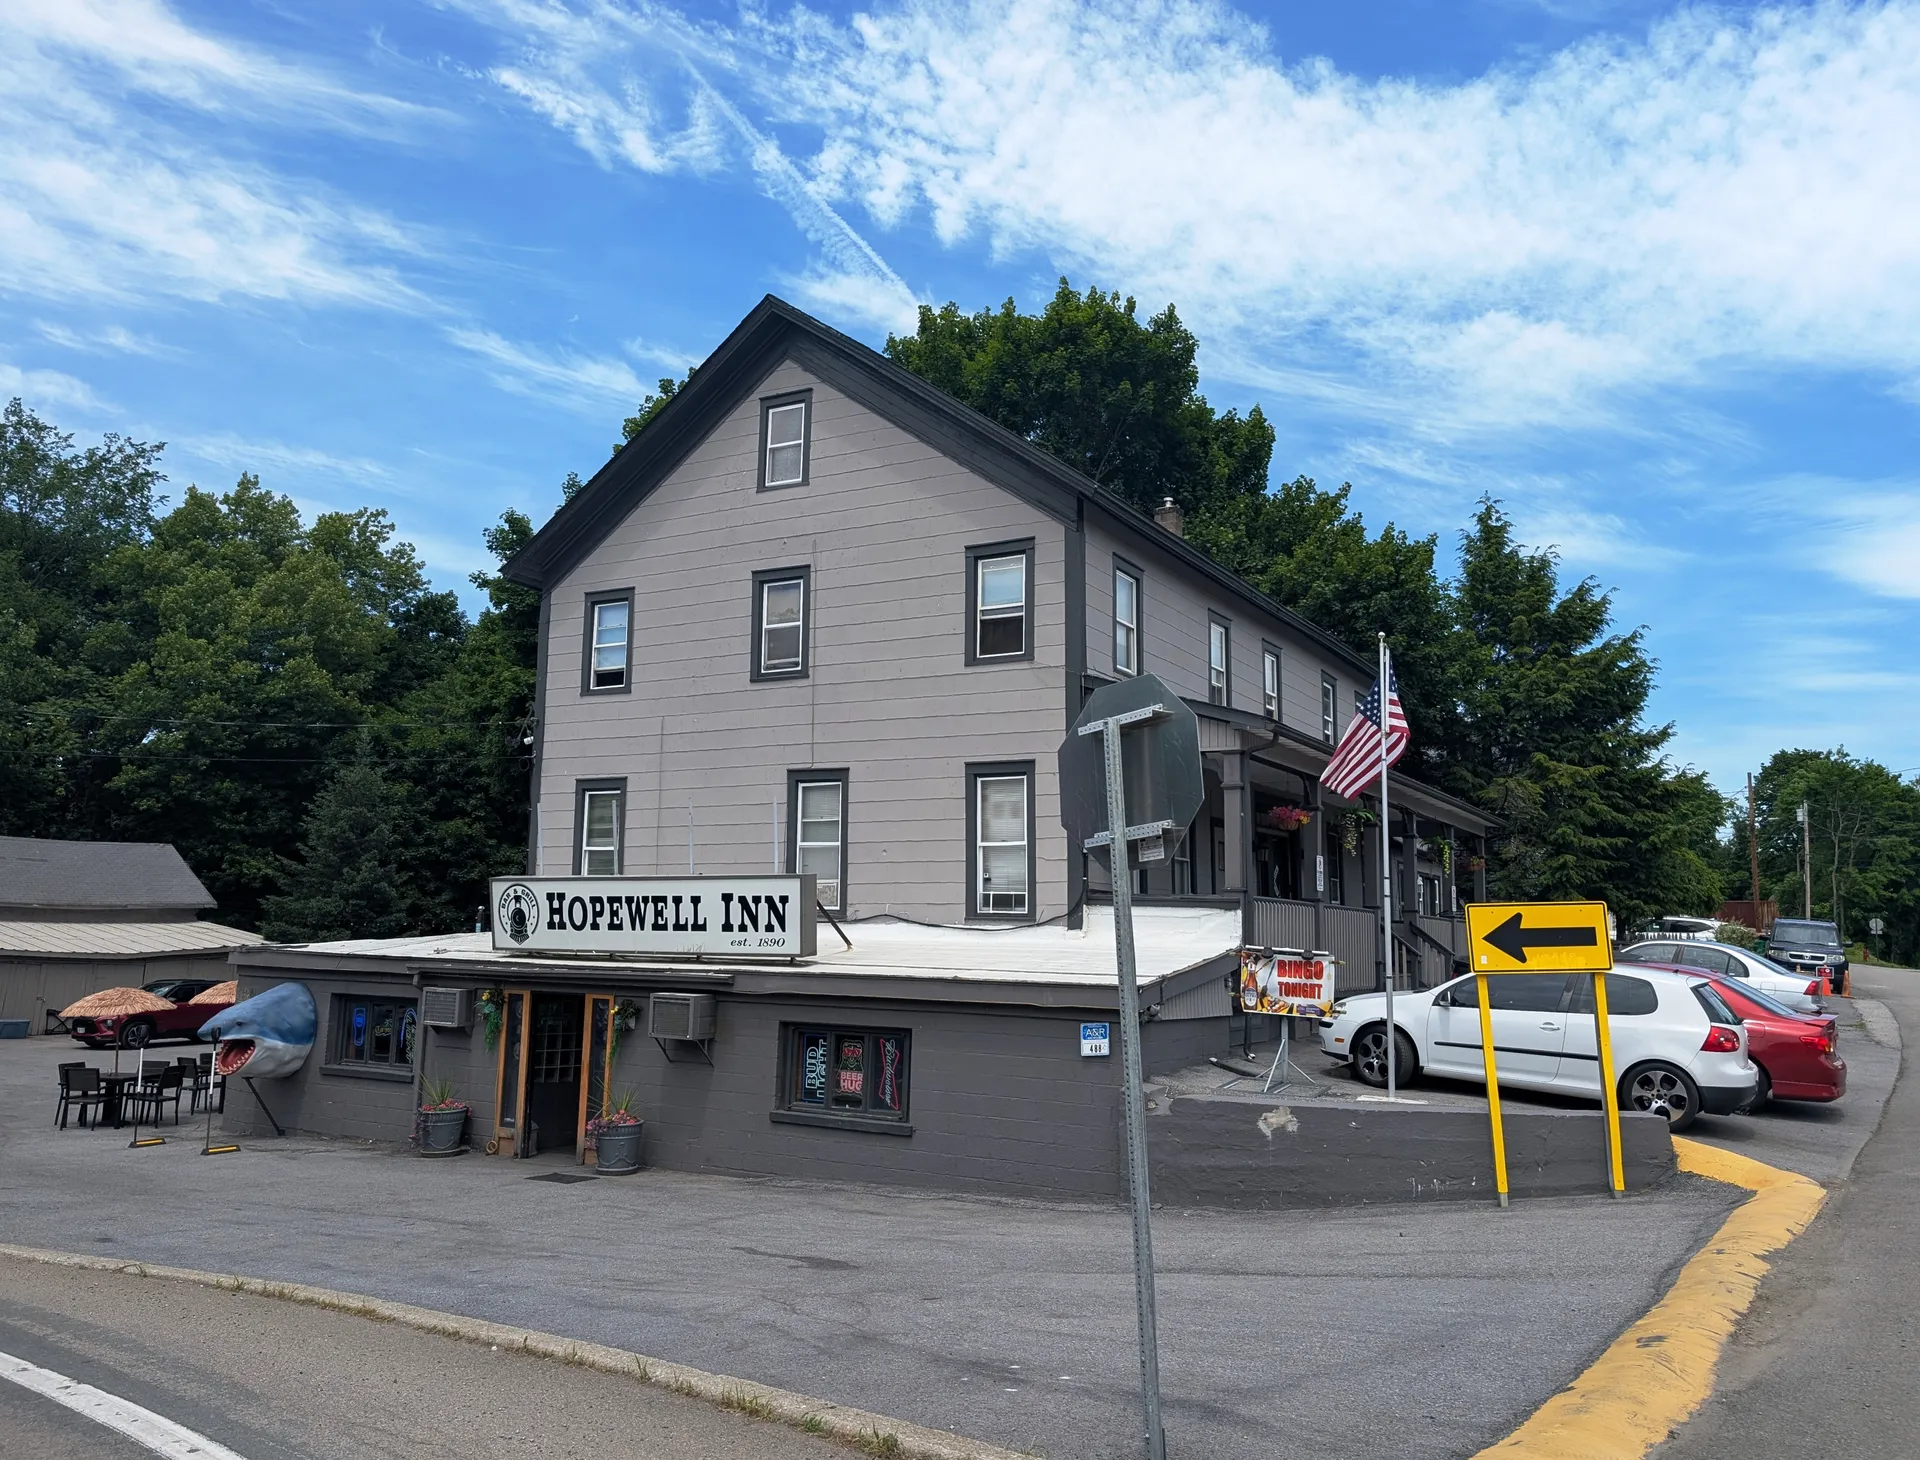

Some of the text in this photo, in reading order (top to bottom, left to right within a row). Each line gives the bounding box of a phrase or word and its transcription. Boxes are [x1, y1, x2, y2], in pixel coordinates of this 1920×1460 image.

[501, 892, 511, 909] BAR
[521, 889, 536, 909] GRILL
[546, 892, 789, 932] HOPEWELL INN
[730, 937, 786, 947] est. 1890
[1277, 959, 1324, 980] BINGO
[1278, 981, 1323, 1000] TONIGHT
[805, 1046, 819, 1089] BUD
[840, 1072, 864, 1081] BEER
[885, 1039, 896, 1106] Budweiser
[840, 1080, 863, 1091] HUG
